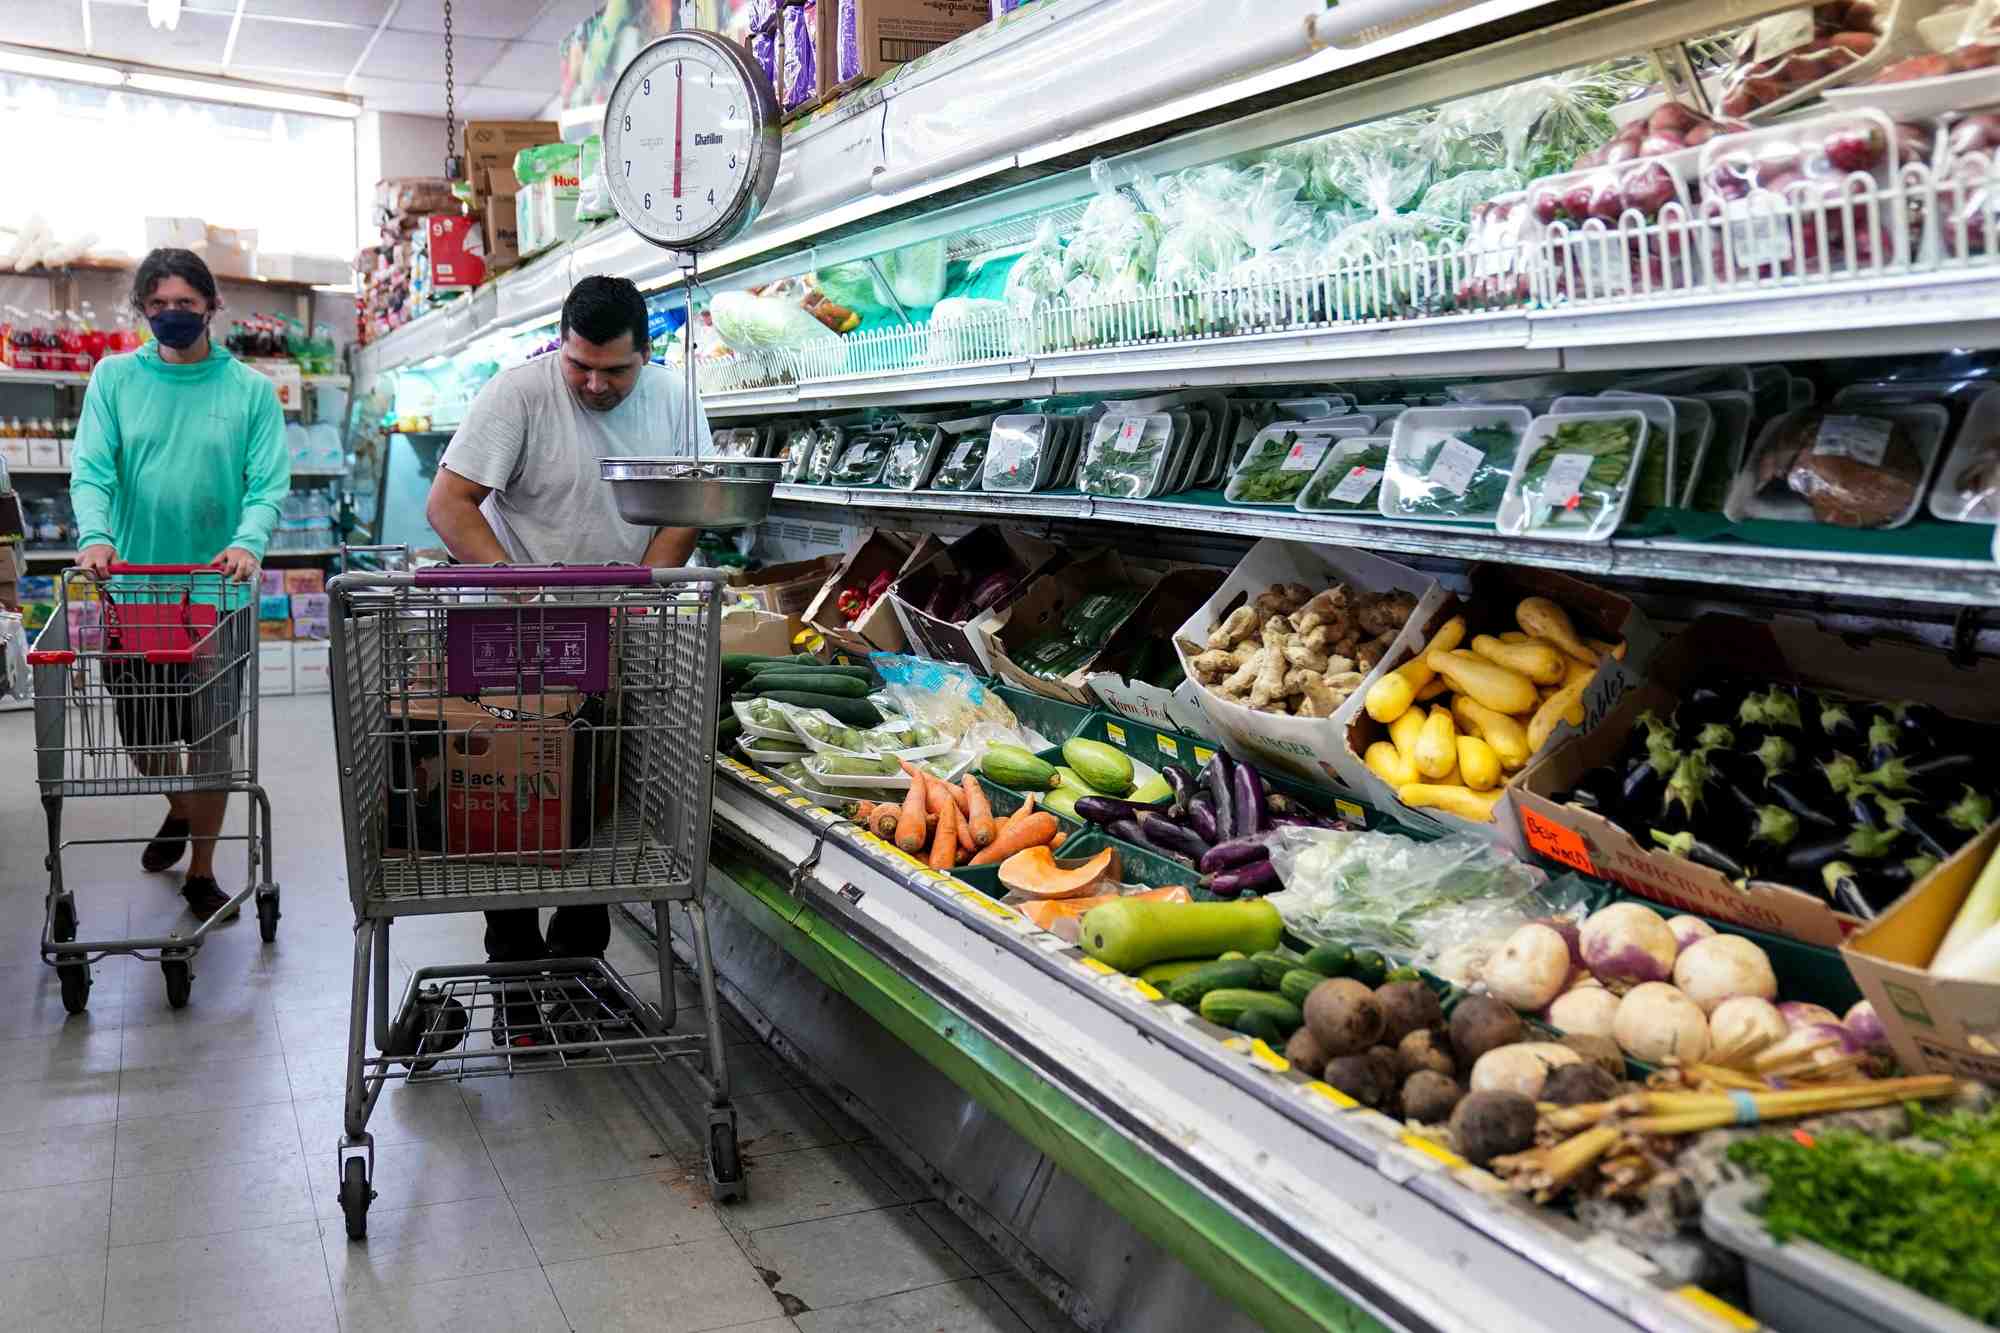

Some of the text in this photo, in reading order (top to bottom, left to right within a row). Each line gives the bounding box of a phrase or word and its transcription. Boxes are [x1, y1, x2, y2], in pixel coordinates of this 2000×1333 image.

[643, 78, 651, 96] 9
[624, 115, 632, 132] 8
[694, 133, 723, 146] Chatillon
[625, 160, 631, 177] 7
[728, 153, 736, 169] 3
[644, 193, 651, 210] 6
[707, 188, 714, 206] 4
[675, 204, 682, 222] 5
[1249, 731, 1315, 757] INGER
[451, 769, 505, 785] Black
[451, 793, 511, 811] Jack
